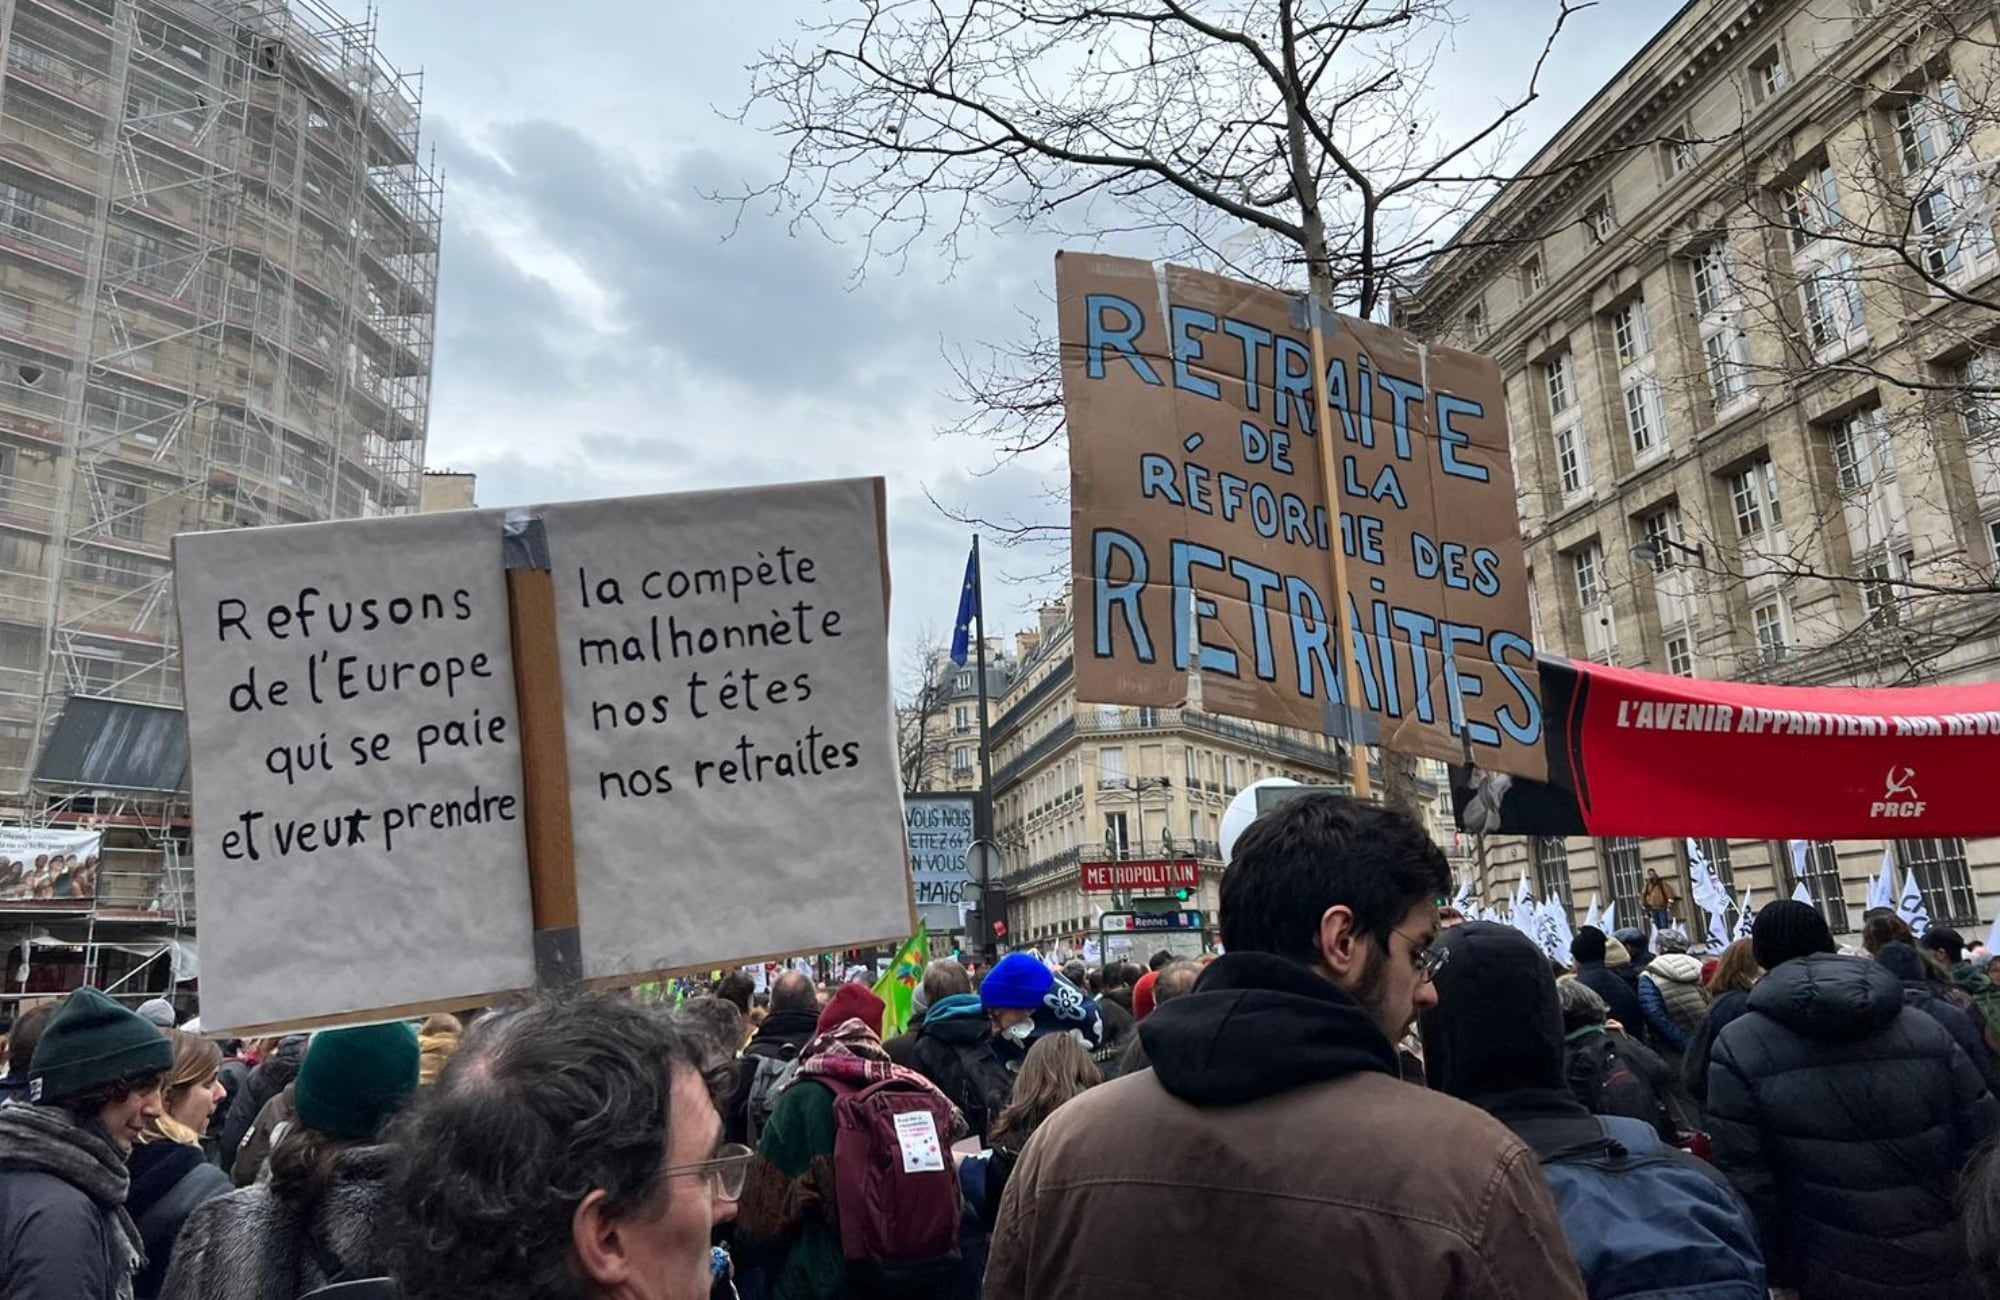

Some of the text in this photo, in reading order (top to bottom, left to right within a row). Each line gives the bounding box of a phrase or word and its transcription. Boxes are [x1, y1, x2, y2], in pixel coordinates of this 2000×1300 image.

[1239, 420, 1407, 509] DE LA
[1140, 432, 1501, 596] RÉFORME DES
[579, 546, 816, 608] la compète
[217, 587, 472, 641] Refusons
[229, 649, 492, 713] de l'Europe
[592, 668, 812, 730] nos têtes
[266, 708, 506, 785] qui se paie
[1616, 700, 1733, 733] L'AVENIR
[599, 725, 859, 800] nos retraites
[221, 809, 264, 861] et
[383, 785, 516, 851] prendre
[1870, 801, 1927, 818] PRCF
[927, 855, 965, 872] VOUS
[1087, 865, 1194, 884] METROPOLITAIN
[1135, 917, 1168, 928] Rennes
